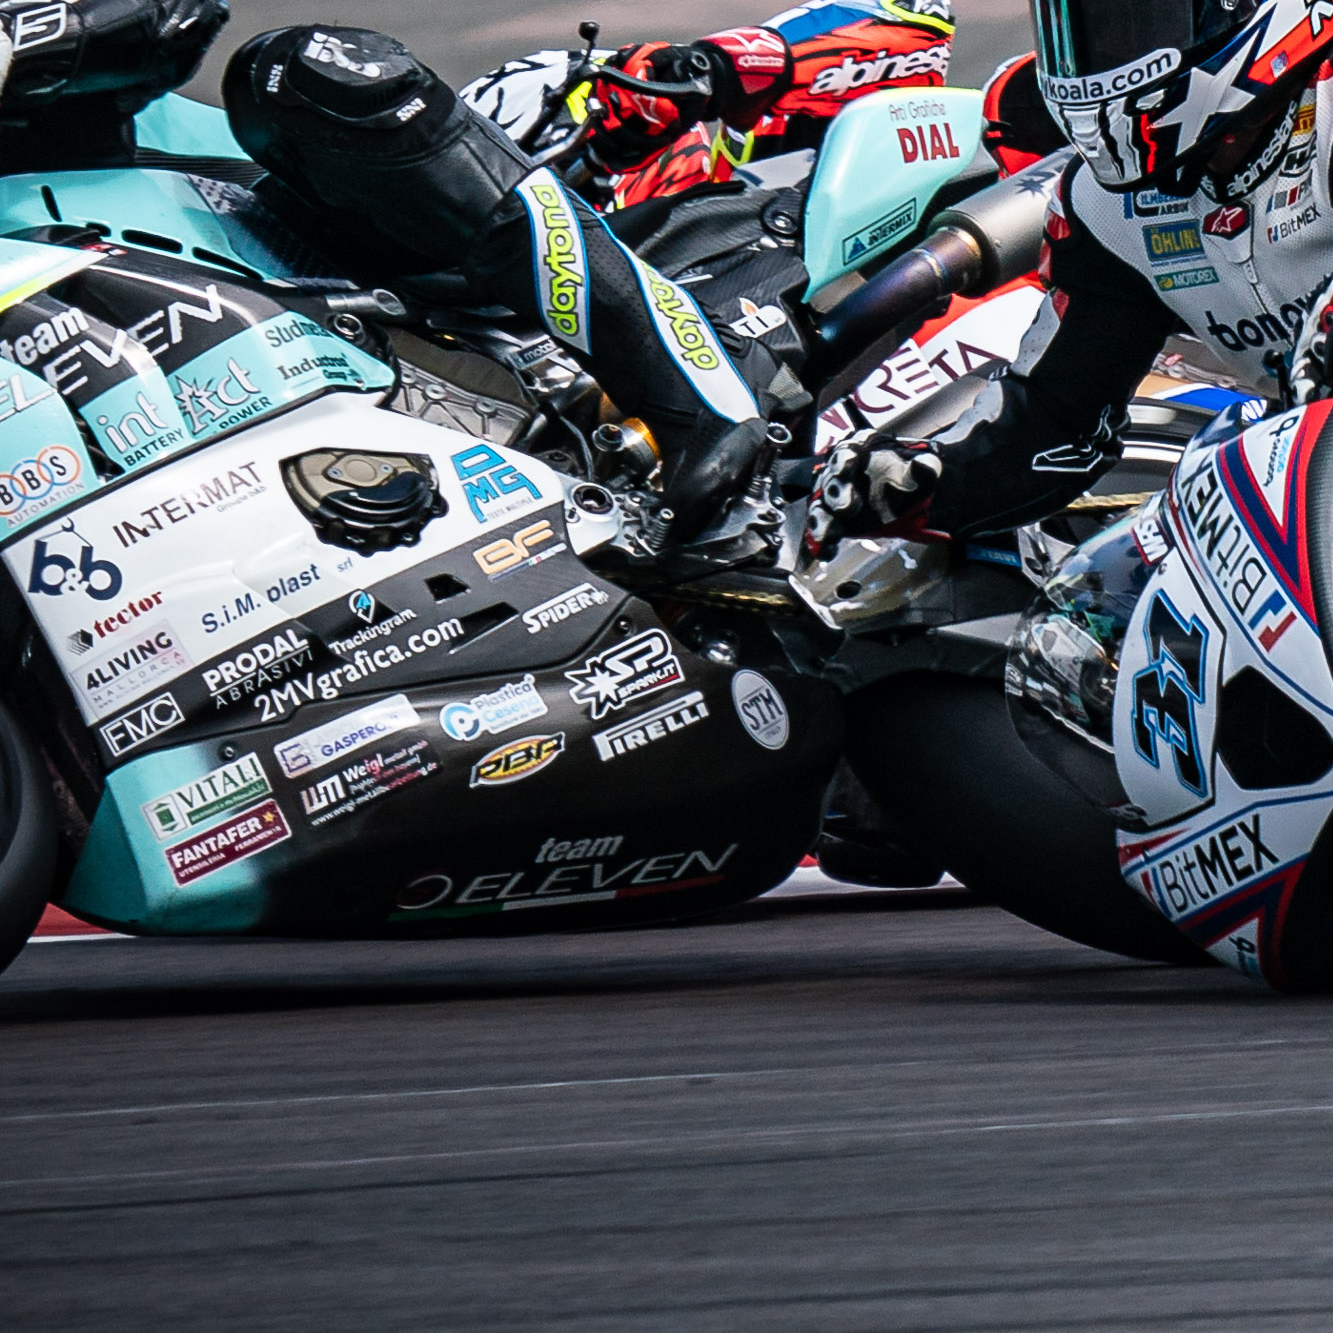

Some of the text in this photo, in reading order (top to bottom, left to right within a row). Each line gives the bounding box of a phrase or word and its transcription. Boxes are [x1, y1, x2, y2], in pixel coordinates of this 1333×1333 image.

[896, 122, 961, 164] DIAL
[1280, 202, 1322, 238] BitMEX
[530, 185, 583, 336] daytona
[0, 307, 90, 366] team
[123, 396, 273, 467] BATTERY POWER
[8, 482, 85, 526] AUTOMATION
[112, 462, 262, 548] INTERMAT
[1181, 451, 1268, 616] BitMEX
[93, 591, 163, 639] tector
[201, 557, 354, 633] S.i.M. plast srl
[522, 582, 594, 634] SPIDER
[328, 608, 417, 655] Trackingram
[86, 631, 173, 690] 4LIVING
[202, 628, 309, 692] PRODAL
[216, 649, 313, 709] ABRASIVI
[254, 618, 465, 722] 2MVgrafica.com
[474, 682, 532, 709] Plastica
[742, 688, 784, 731] STM
[1131, 587, 1209, 799] 31
[105, 699, 177, 752] FMC
[592, 691, 709, 762] PIRELLI
[176, 757, 262, 809] VITALI
[342, 753, 385, 783] Weigl
[170, 816, 263, 869] FANTAFER
[535, 835, 624, 863] team
[1159, 813, 1280, 913] BitMEX
